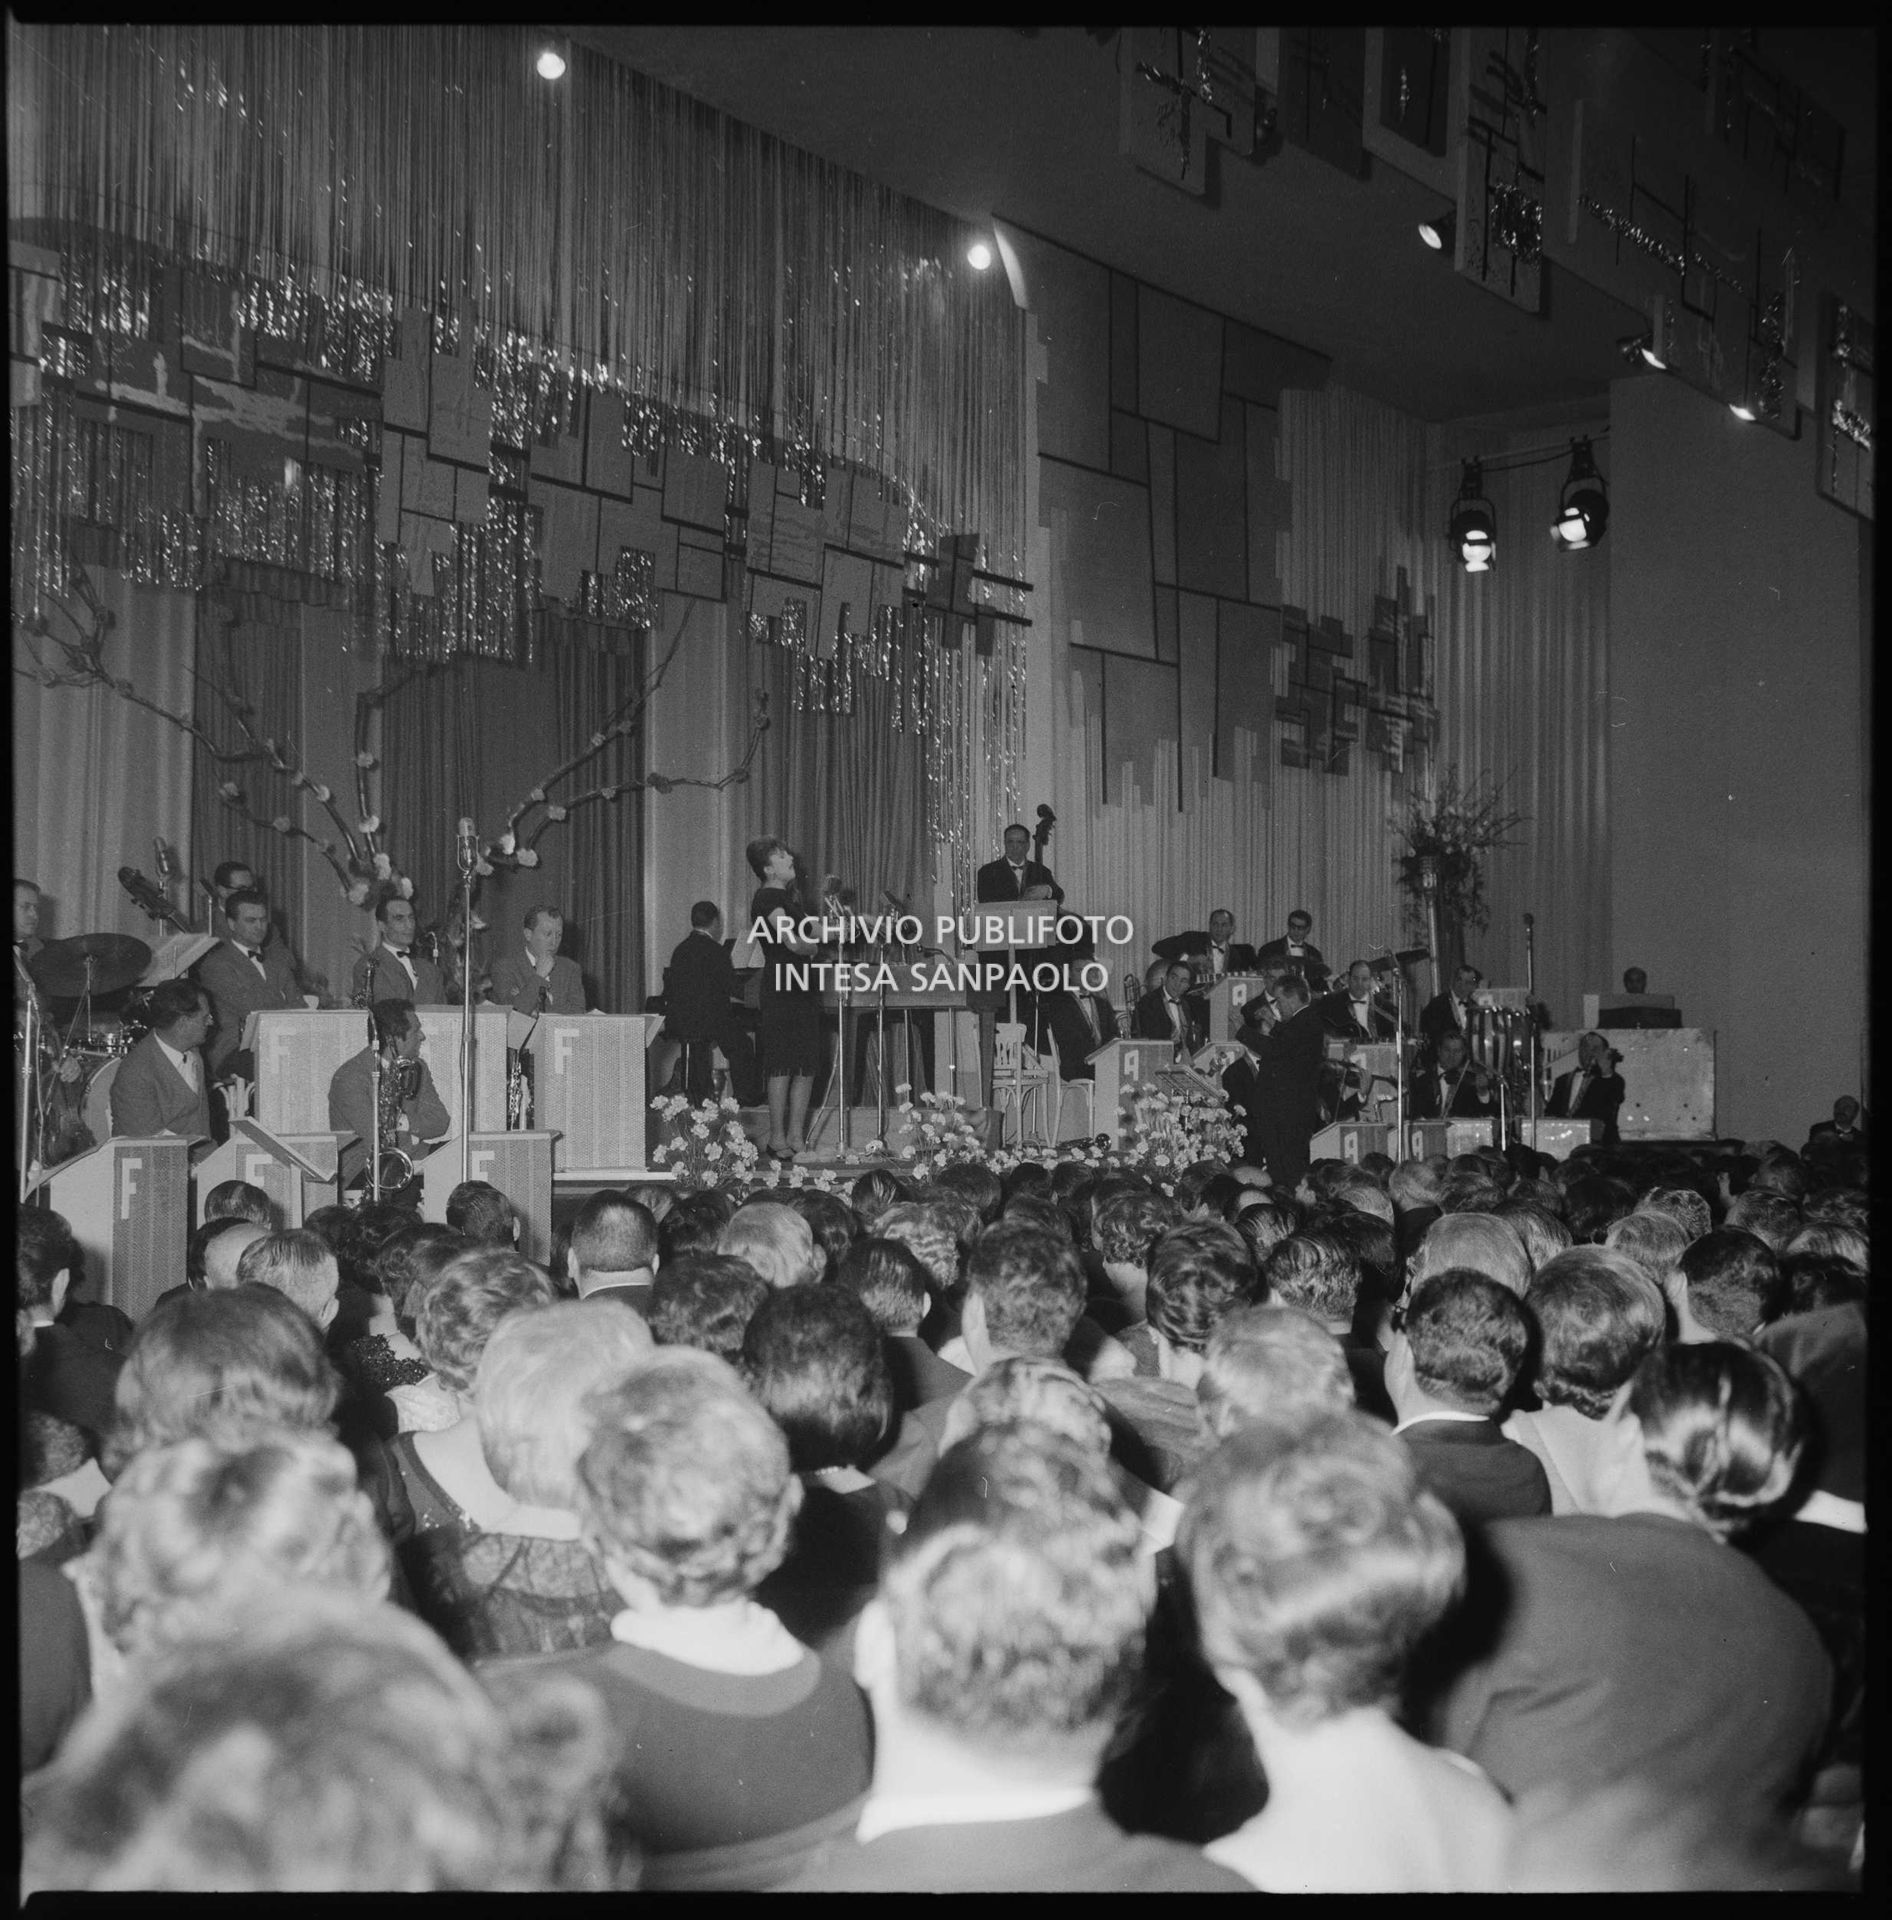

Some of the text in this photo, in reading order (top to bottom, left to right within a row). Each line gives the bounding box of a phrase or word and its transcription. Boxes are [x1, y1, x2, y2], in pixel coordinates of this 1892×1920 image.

[269, 1027, 297, 1074] F
[554, 1028, 580, 1075] F
[121, 1158, 143, 1220] F
[245, 1154, 273, 1188] F
[471, 1150, 495, 1182] F
